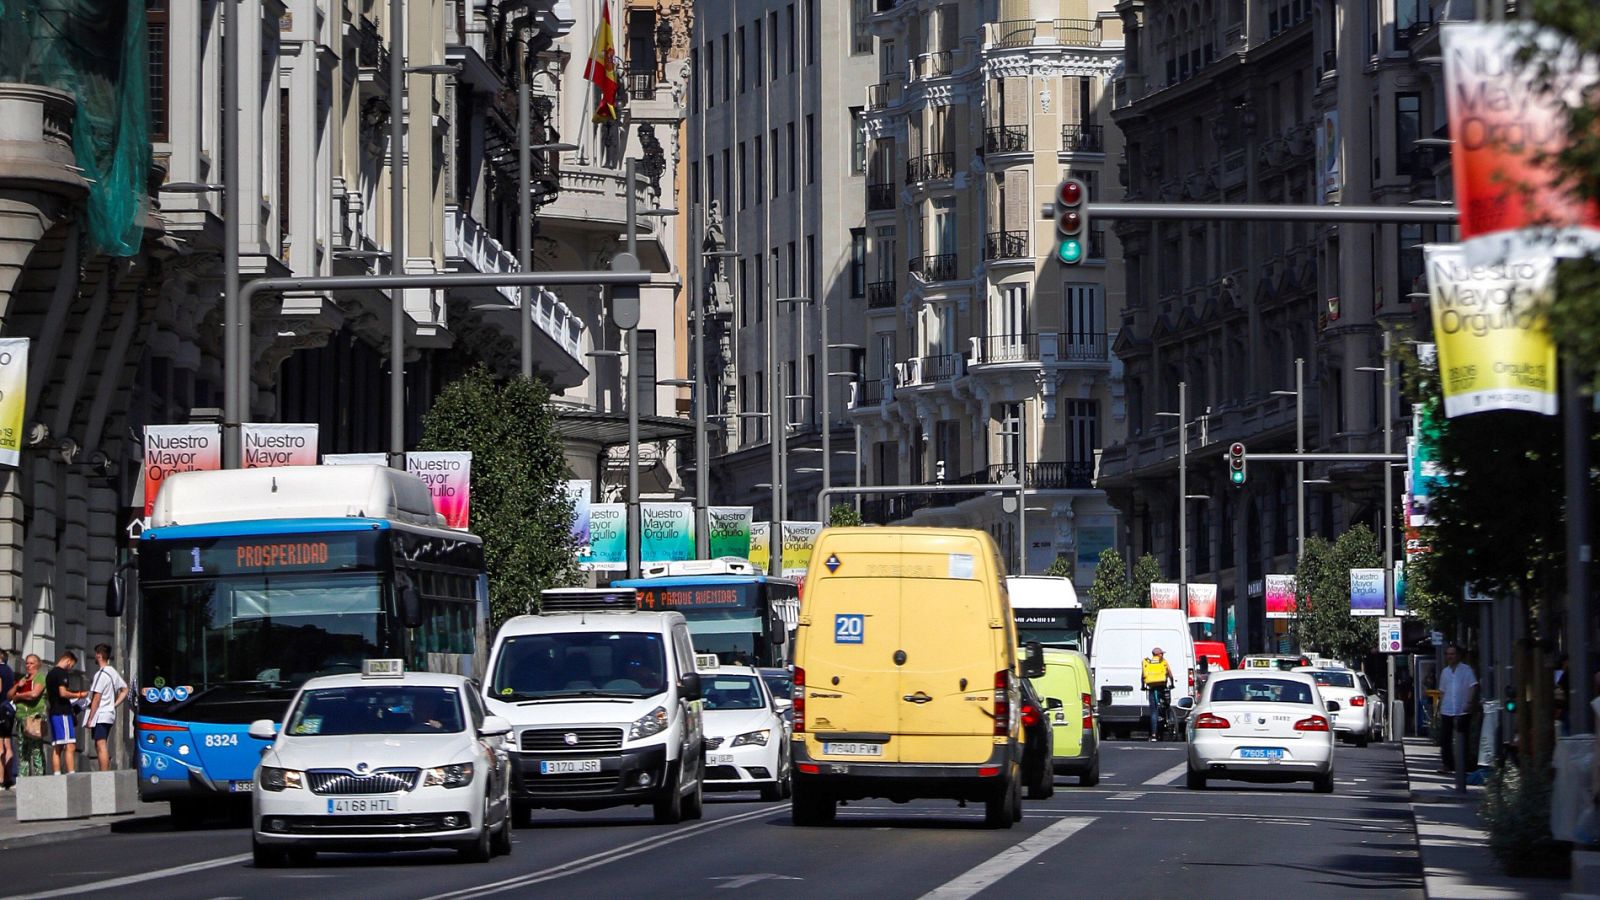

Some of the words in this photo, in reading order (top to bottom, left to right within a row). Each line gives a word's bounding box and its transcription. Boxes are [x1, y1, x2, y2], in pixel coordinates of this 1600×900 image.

[148, 434, 209, 449] Nuestro
[245, 433, 305, 448] Nuestro
[148, 450, 196, 468] Mayor
[245, 449, 293, 466] Mayor
[409, 458, 461, 470] Nuestro
[643, 508, 683, 518] Nuestro
[710, 512, 746, 520] Nuestro
[590, 521, 611, 531] ayor
[643, 518, 675, 530] Mayor
[710, 521, 738, 531] Mayor
[784, 525, 816, 534] Nuestro
[644, 529, 679, 541] Orgullo
[711, 529, 744, 540] Orgullo
[784, 534, 809, 543] Mayor
[784, 542, 814, 552] Orgullo
[191, 547, 204, 572] 1
[237, 543, 328, 568] PROSPERIDAD
[1351, 580, 1373, 588] Mayor
[1351, 587, 1377, 595] Orgullo
[661, 591, 692, 605] PARQUE
[695, 590, 737, 604] AVENIDAS
[837, 617, 861, 635] 20
[371, 662, 389, 673] TAXI
[1253, 660, 1270, 668] TAXI
[205, 734, 238, 747] 8324
[549, 762, 573, 773] 3170
[578, 760, 597, 772] JSR
[336, 800, 367, 811] 4168
[370, 800, 394, 811] HTL
